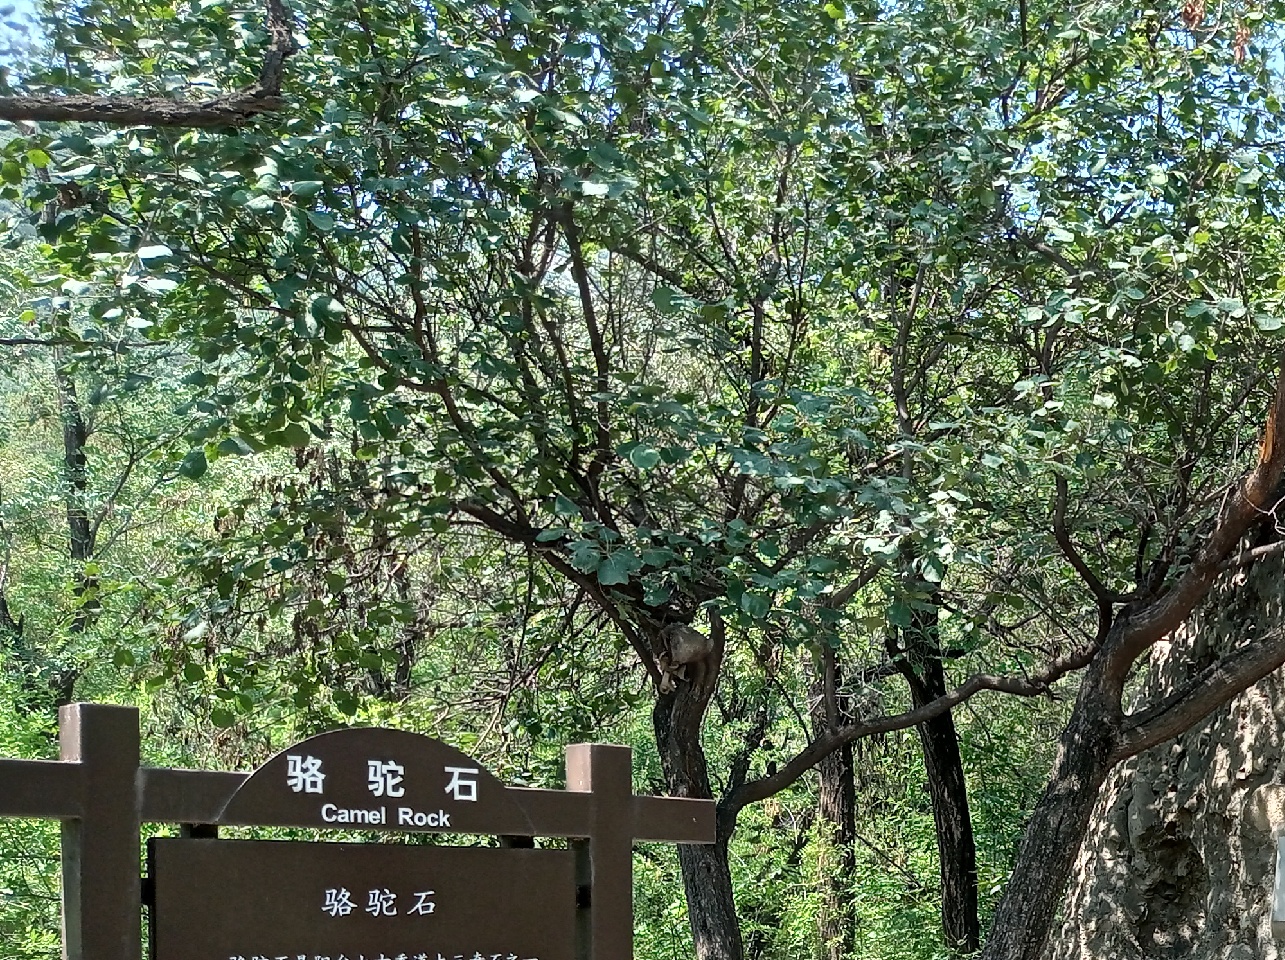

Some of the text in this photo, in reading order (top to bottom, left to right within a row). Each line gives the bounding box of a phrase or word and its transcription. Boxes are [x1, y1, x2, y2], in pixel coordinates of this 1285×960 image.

[286, 755, 480, 802] 骆驼石
[321, 803, 451, 828] Camel Rock
[320, 887, 436, 917] 骆驼石
